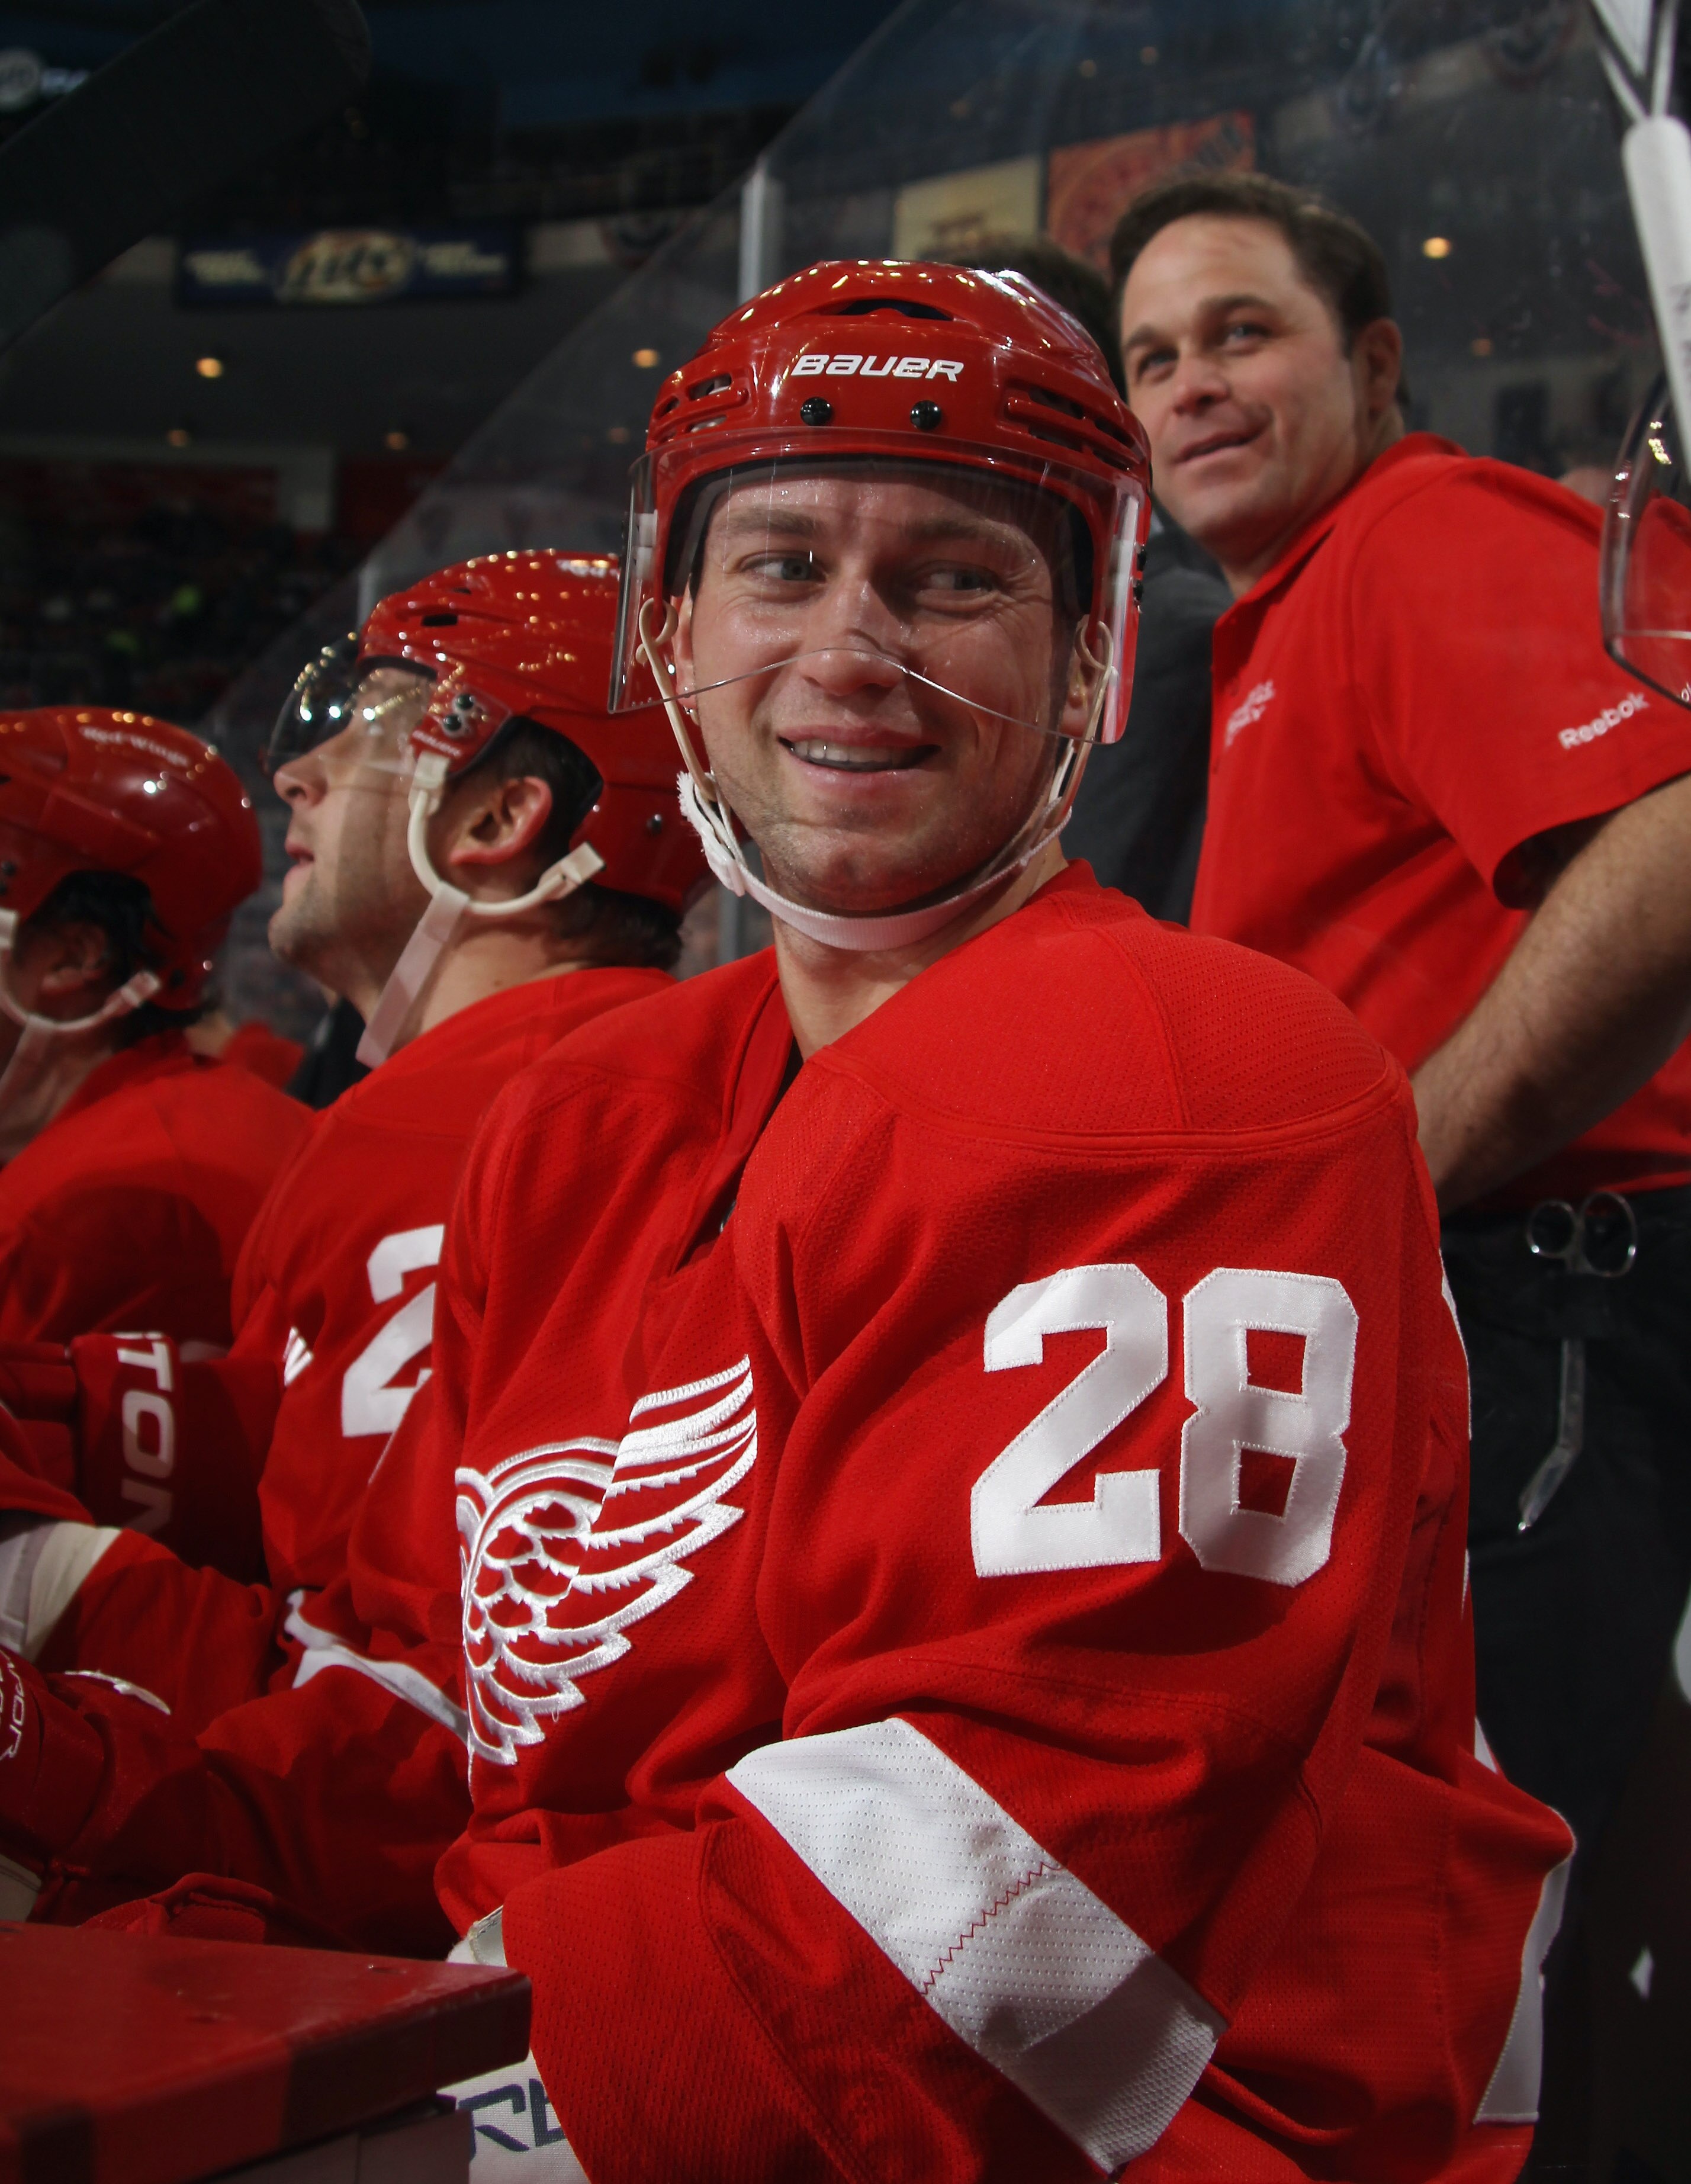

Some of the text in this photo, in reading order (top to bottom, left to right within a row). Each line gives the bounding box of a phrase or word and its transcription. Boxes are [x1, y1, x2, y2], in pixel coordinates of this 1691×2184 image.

[790, 354, 965, 382] BAUER
[1558, 691, 1651, 750] Reebok
[341, 1223, 445, 1438] 2
[970, 1263, 1359, 1588] 28
